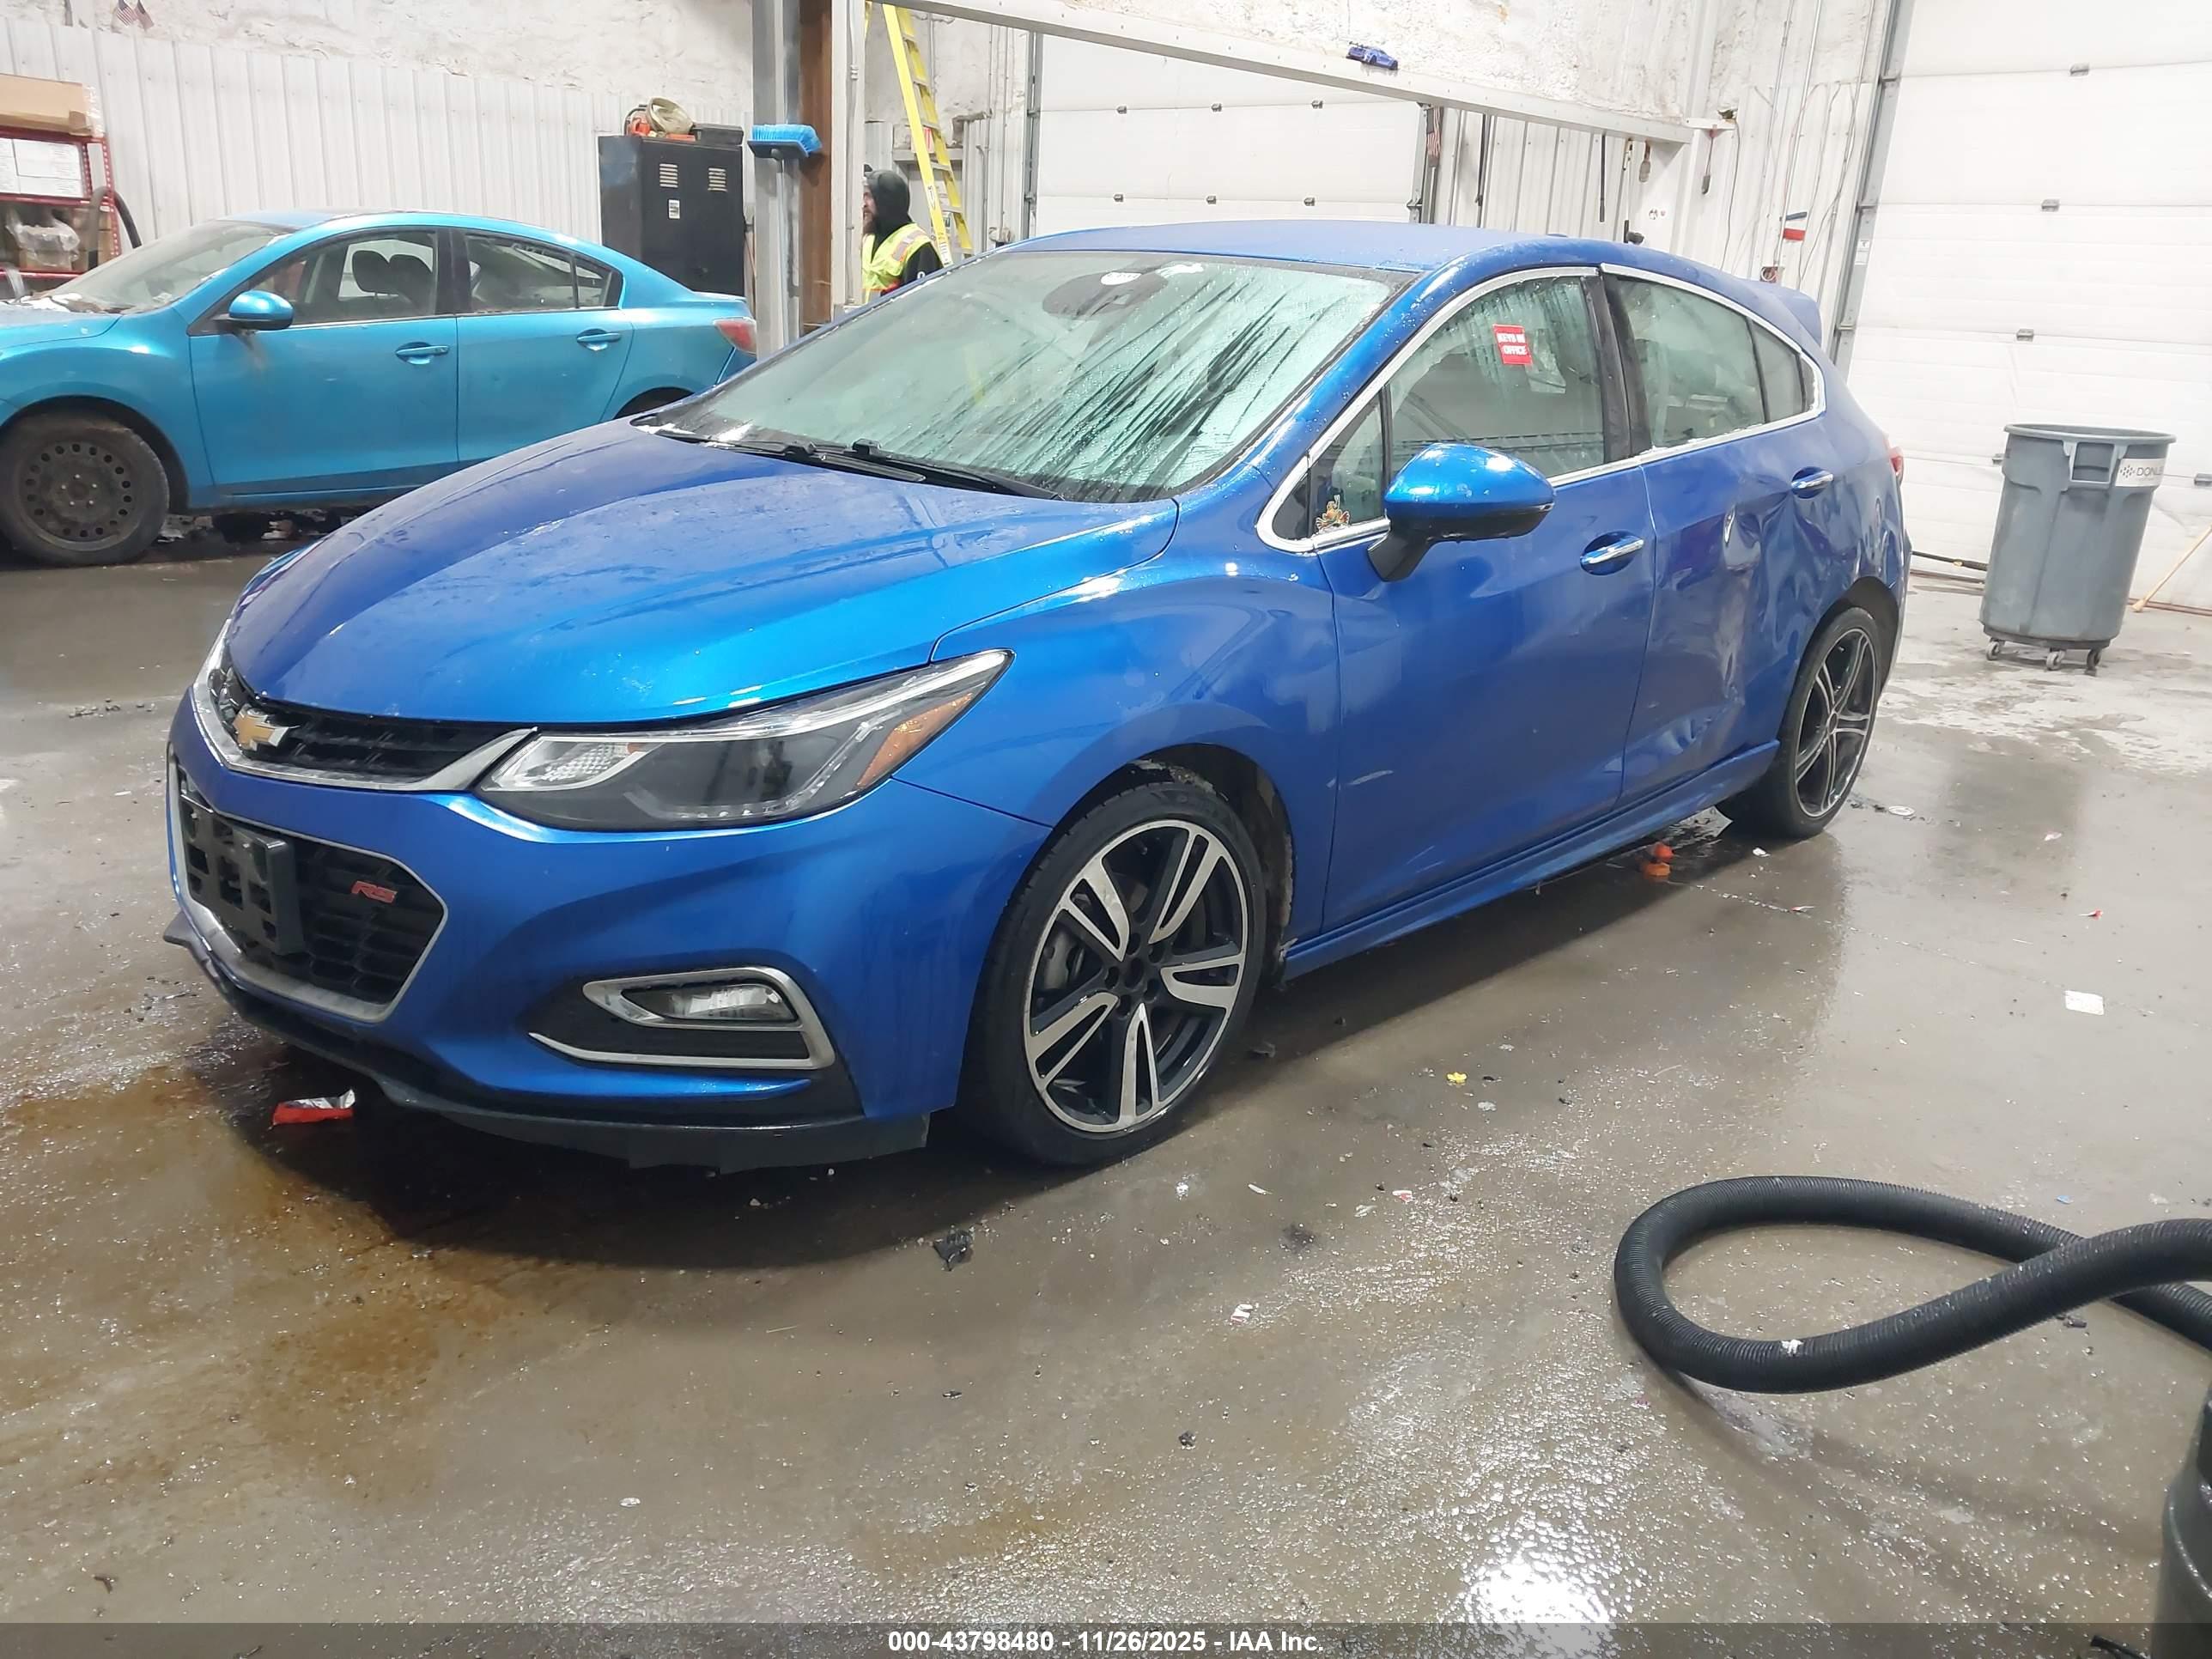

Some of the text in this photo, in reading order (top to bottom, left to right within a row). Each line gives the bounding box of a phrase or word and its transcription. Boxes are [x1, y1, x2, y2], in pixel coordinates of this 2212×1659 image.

[1496, 332, 1516, 343] KEYS
[1502, 344, 1528, 356] OFFICE
[351, 880, 398, 903] RS
